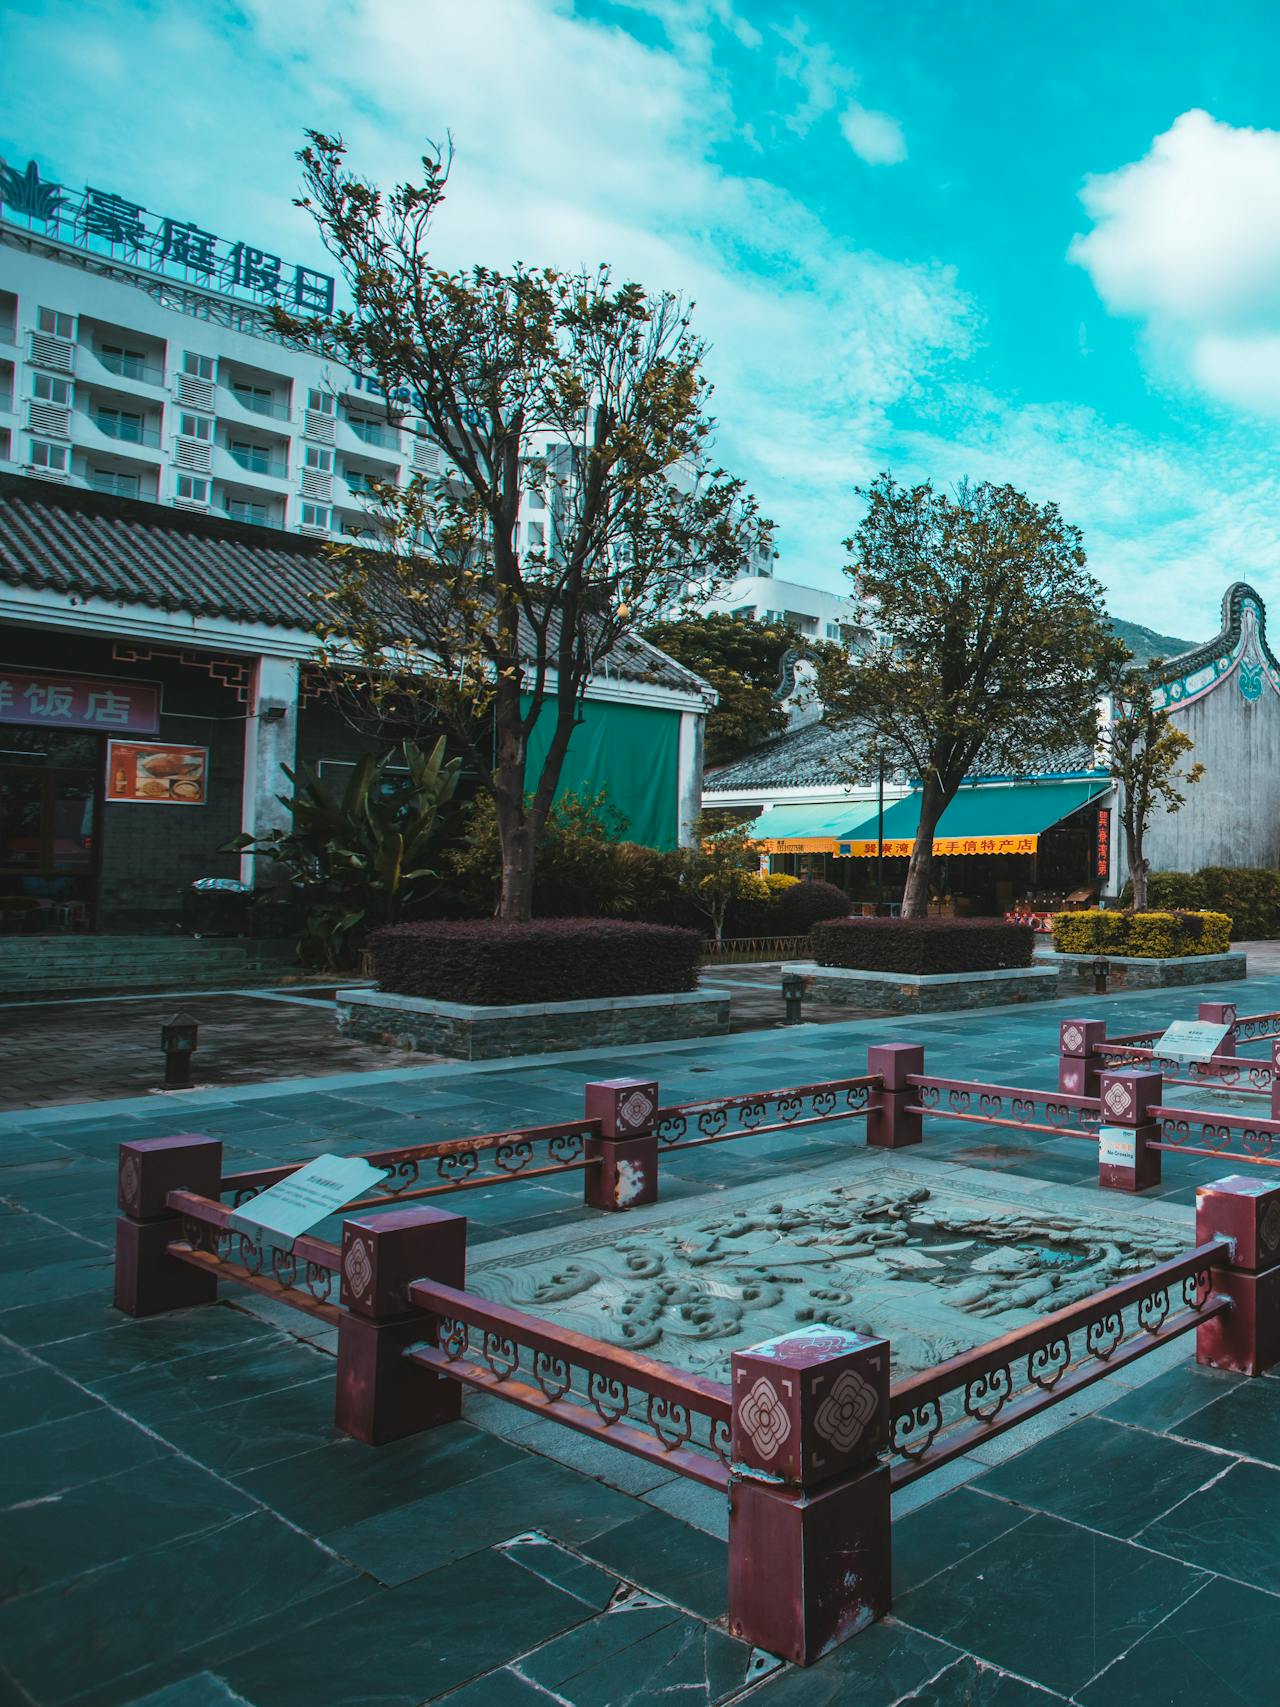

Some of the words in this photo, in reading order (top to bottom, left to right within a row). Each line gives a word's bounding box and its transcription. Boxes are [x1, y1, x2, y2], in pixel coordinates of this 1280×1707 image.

[85, 186, 335, 315] 豪庭假日
[0, 681, 131, 724] 饭店
[864, 839, 1033, 854] 巽寮湾红手信特产店
